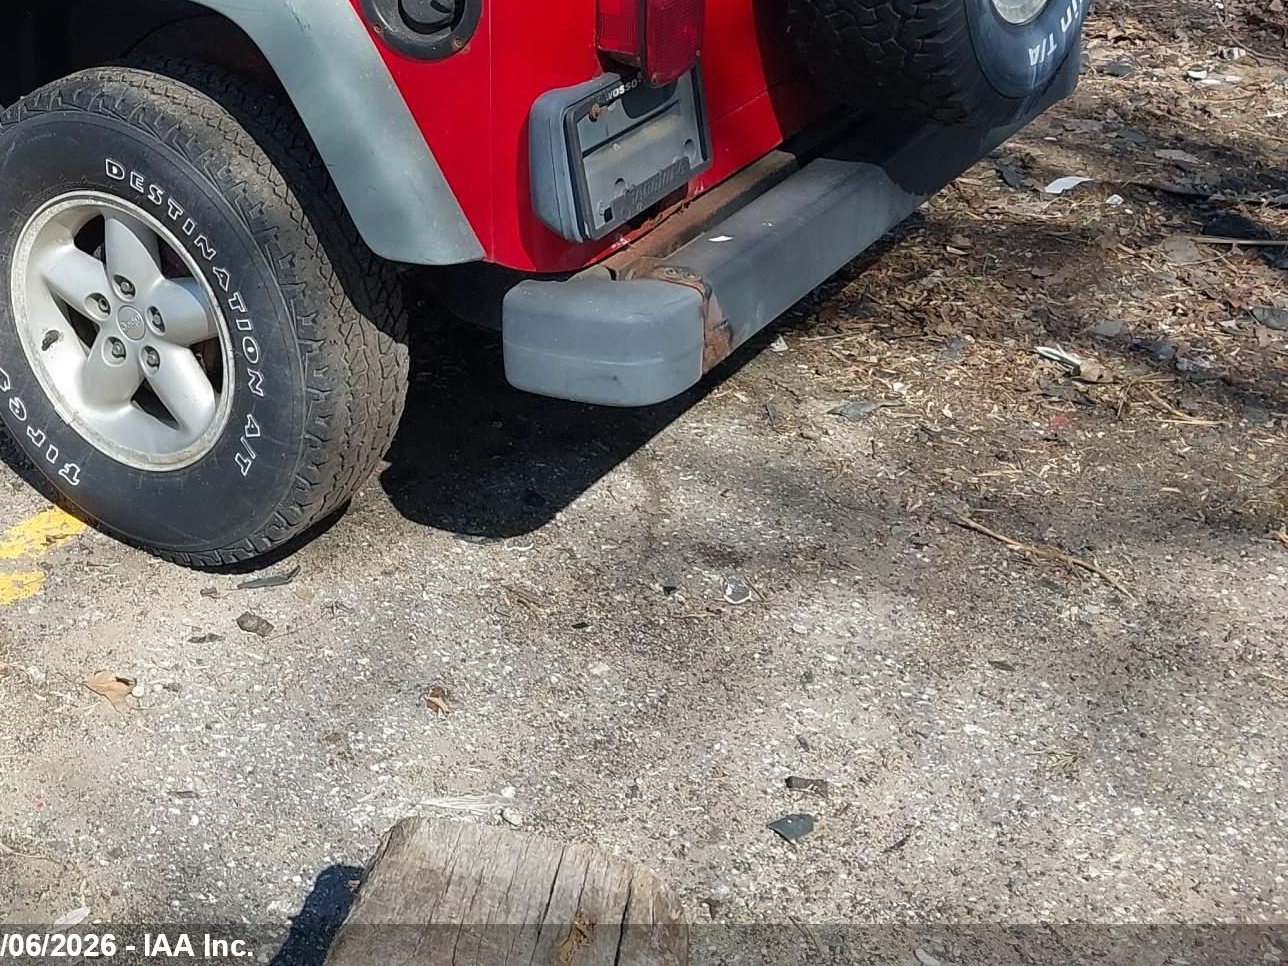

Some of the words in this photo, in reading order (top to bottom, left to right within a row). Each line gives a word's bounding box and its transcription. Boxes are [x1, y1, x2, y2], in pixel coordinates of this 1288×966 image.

[1028, 30, 1058, 68] T/A
[104, 158, 264, 398] DESTINATION
[234, 414, 261, 477] A/T
